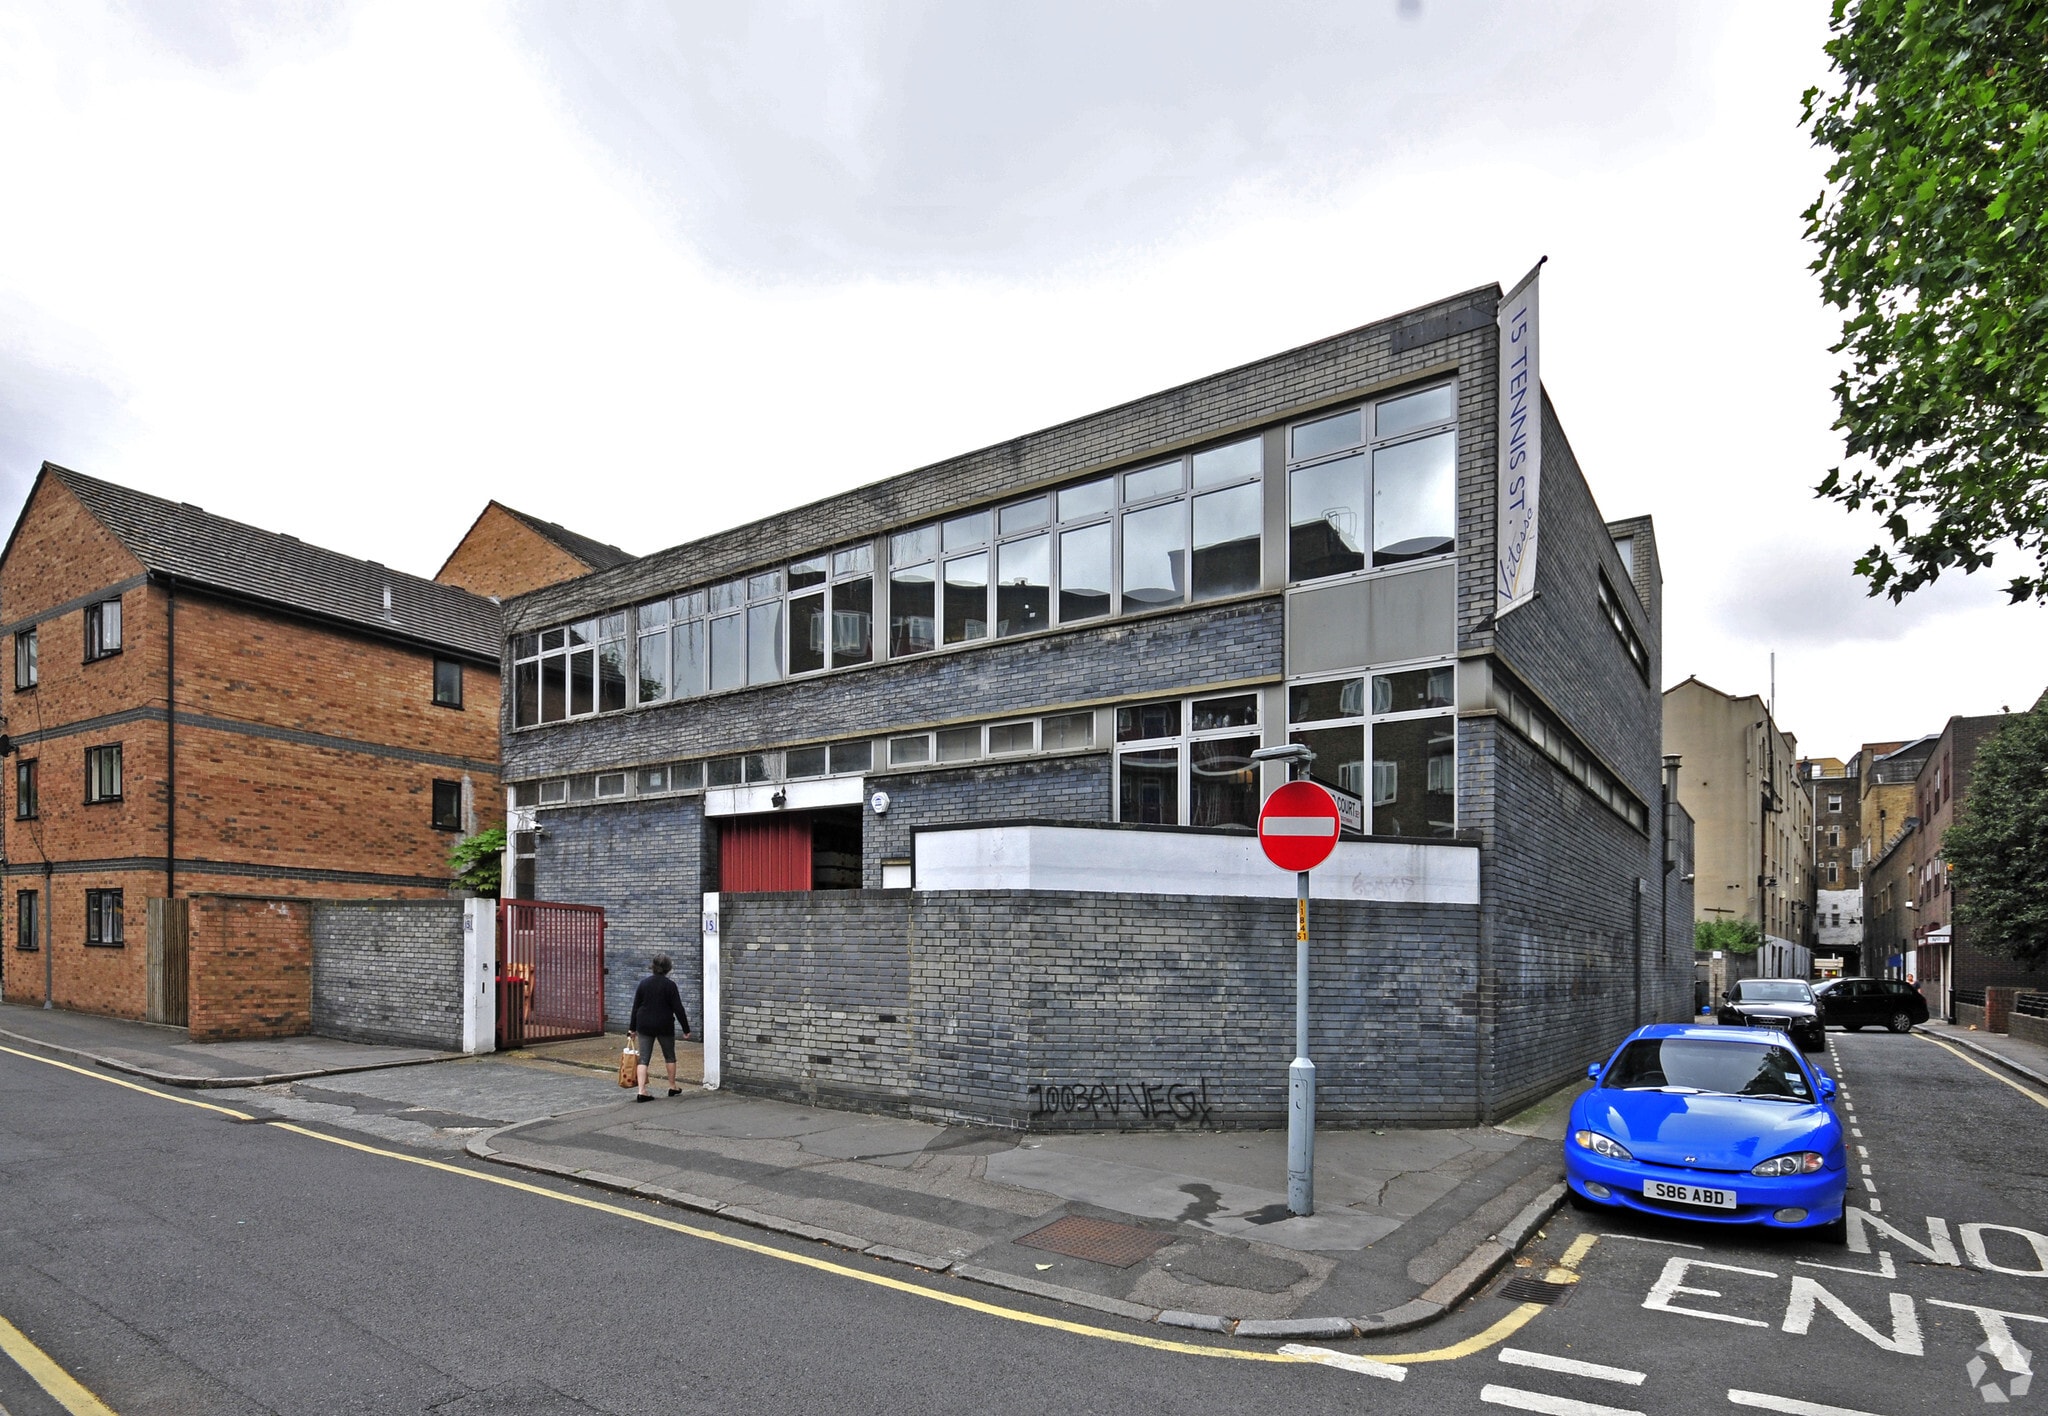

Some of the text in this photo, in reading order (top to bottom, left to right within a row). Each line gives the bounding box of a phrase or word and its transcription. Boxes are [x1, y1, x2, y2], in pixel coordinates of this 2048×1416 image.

[1511, 307, 1527, 343] 15
[1510, 345, 1528, 471] TENNIS
[705, 919, 714, 931] 15
[1656, 1183, 1724, 1205] S86 ABD
[1846, 1206, 2048, 1278] NO
